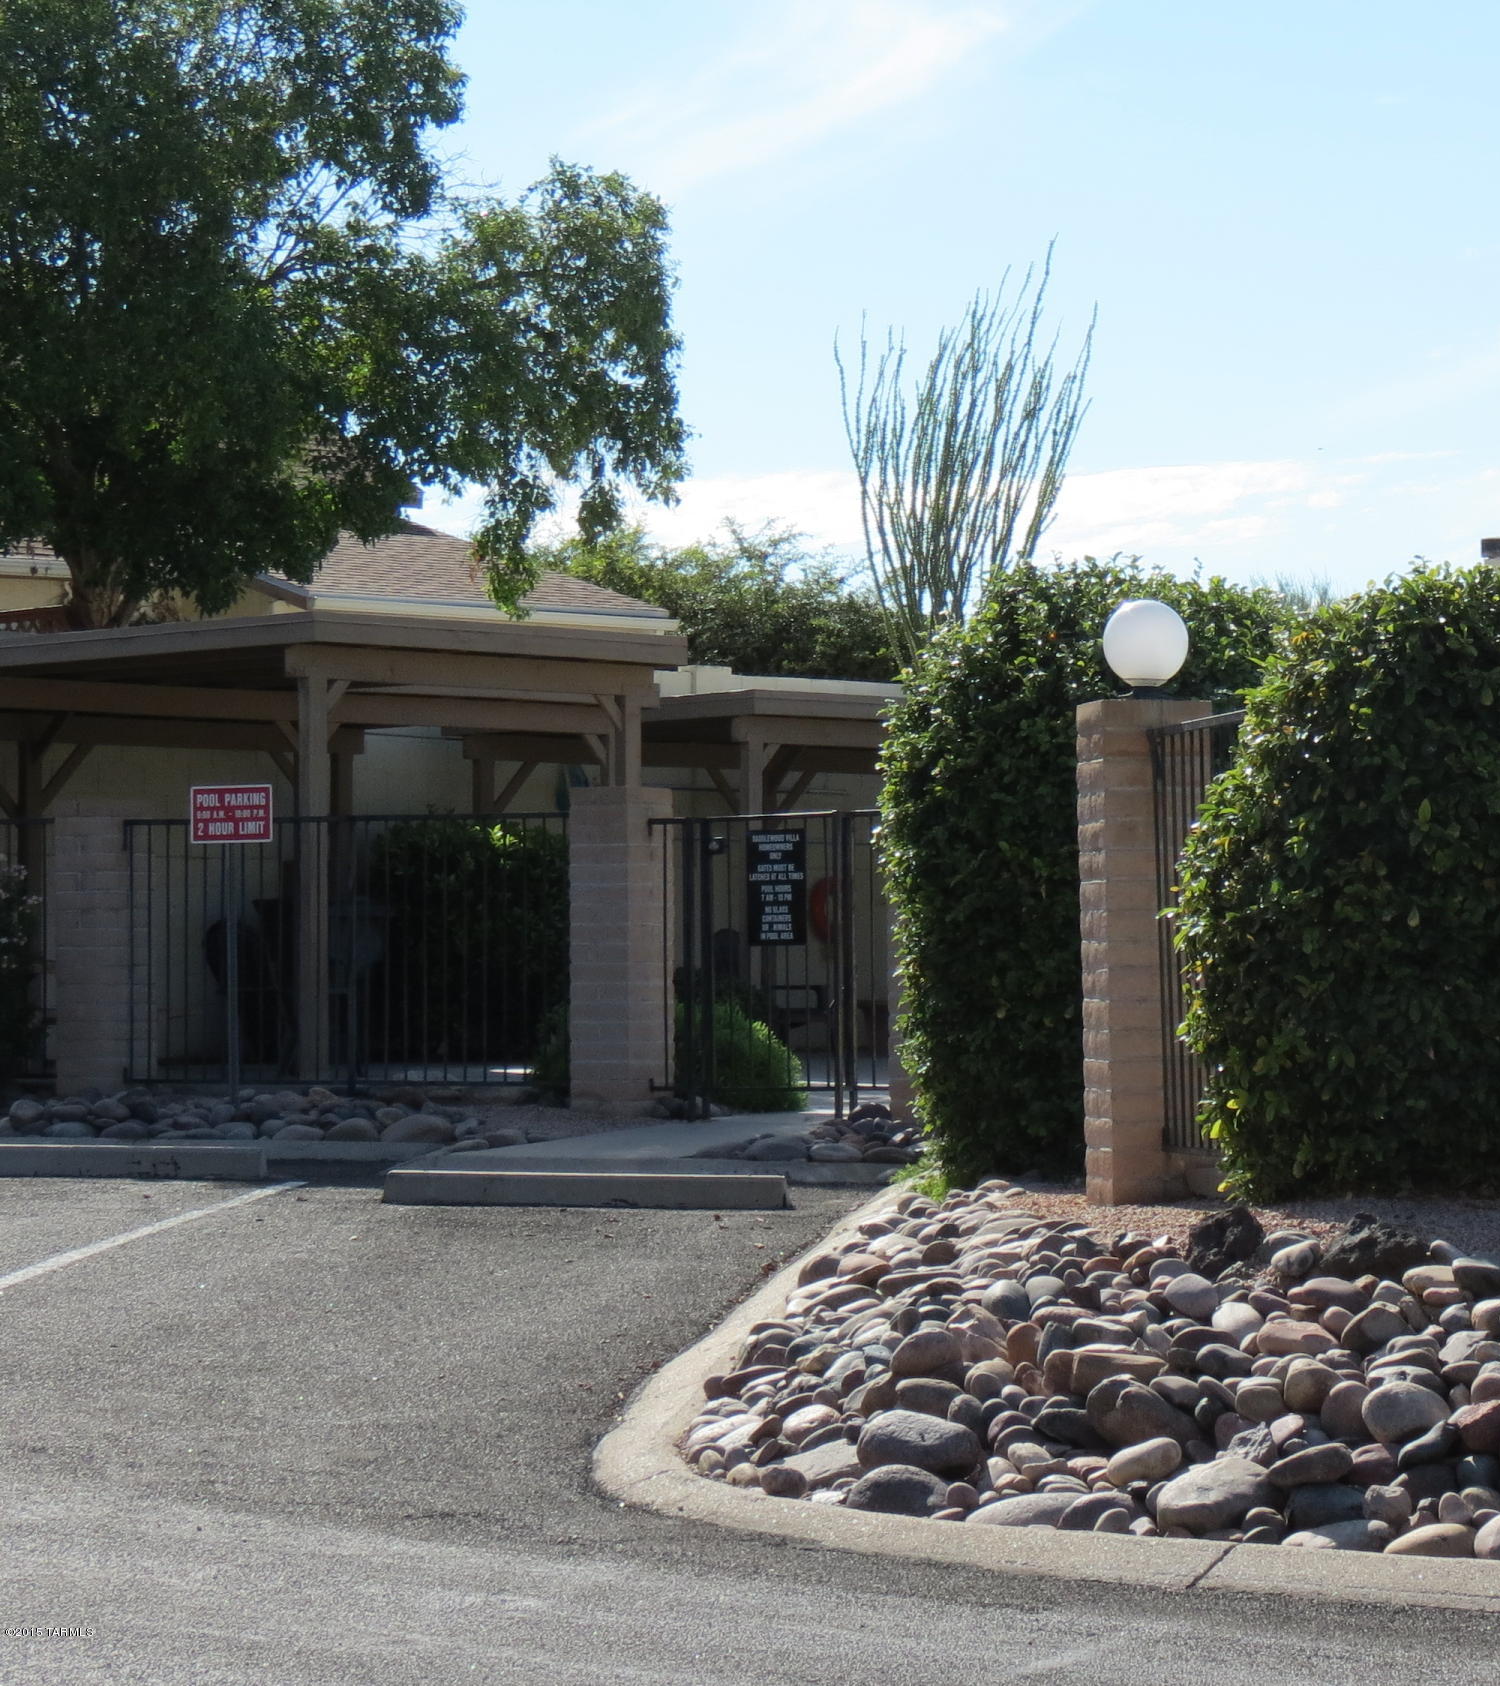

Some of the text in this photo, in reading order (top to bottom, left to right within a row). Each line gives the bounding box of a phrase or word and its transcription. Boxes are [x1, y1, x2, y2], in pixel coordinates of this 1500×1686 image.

[196, 793, 266, 807] POOL PARKING
[198, 821, 265, 836] 2 HOUR LIMIT
[786, 833, 800, 842] VILLA
[758, 843, 793, 851] HOMEOWNERS
[769, 852, 782, 860] ONLY
[757, 864, 795, 872] GATES MUST BE
[749, 873, 770, 881] LATCHED
[771, 873, 777, 881] AT
[788, 872, 804, 880] TIMES
[761, 884, 792, 893] POOL HOURS
[773, 905, 788, 913] GLASS
[762, 915, 792, 923] CONTAINERS
[771, 923, 792, 931] NIMALS
[780, 932, 794, 940] AREA
